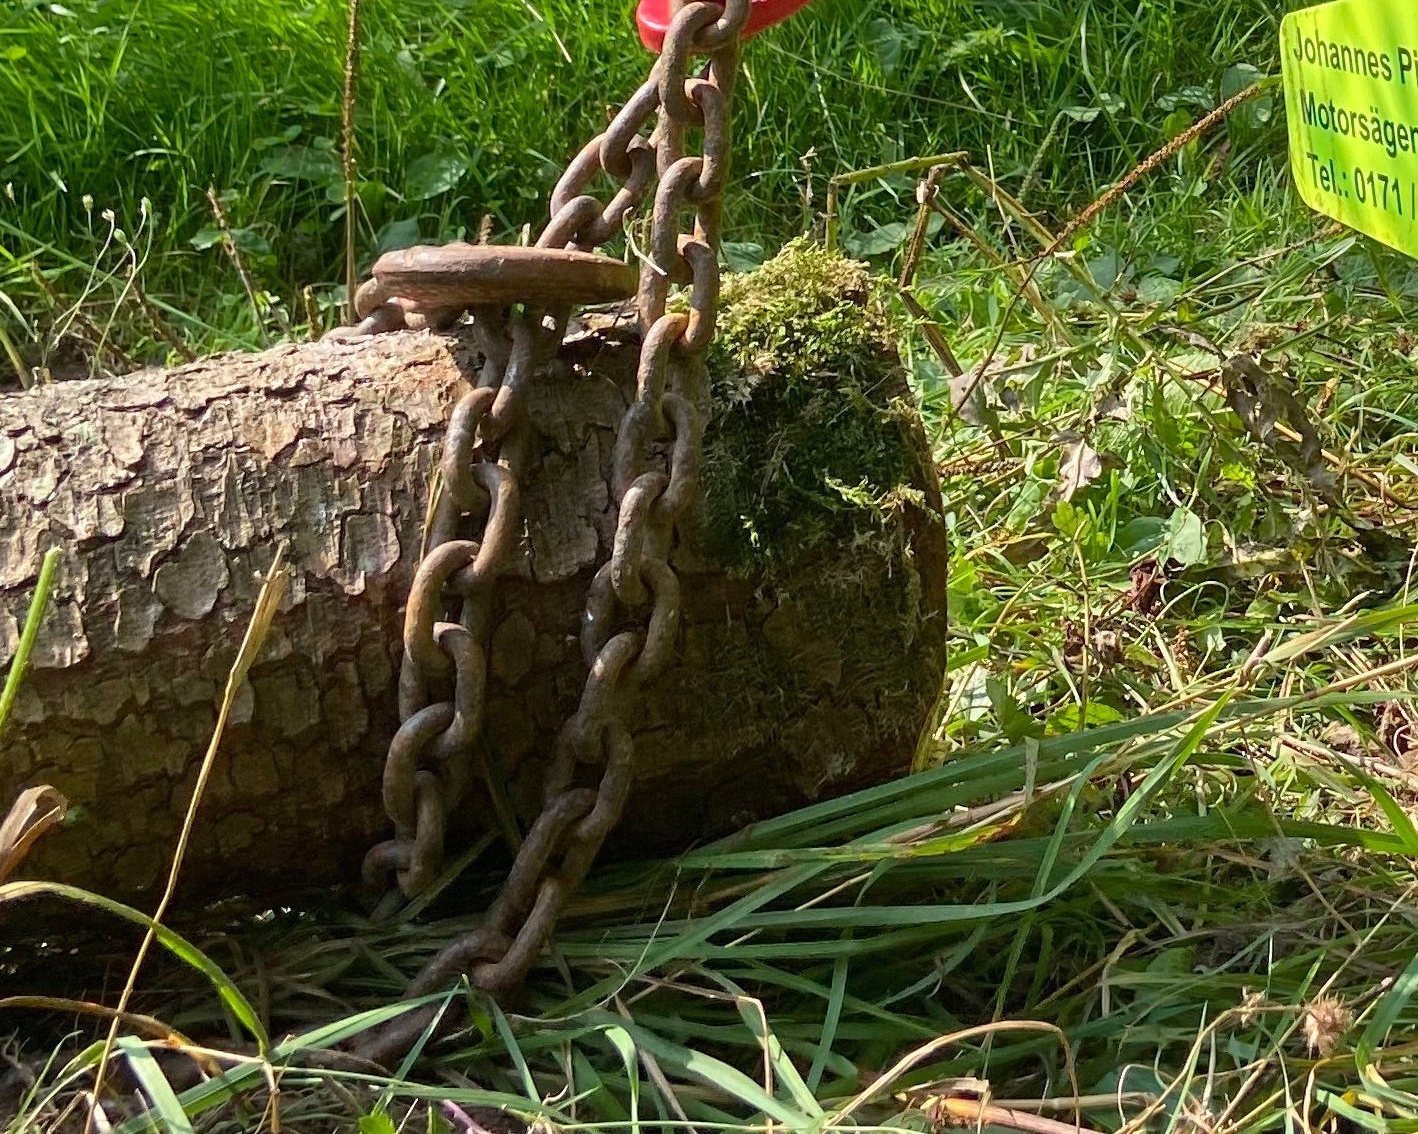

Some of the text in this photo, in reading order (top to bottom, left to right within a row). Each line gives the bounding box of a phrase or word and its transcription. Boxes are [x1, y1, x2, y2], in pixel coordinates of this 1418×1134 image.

[1293, 27, 1392, 81] Johannes
[1306, 152, 1349, 199] Tel.:
[1354, 166, 1403, 216] 0171
